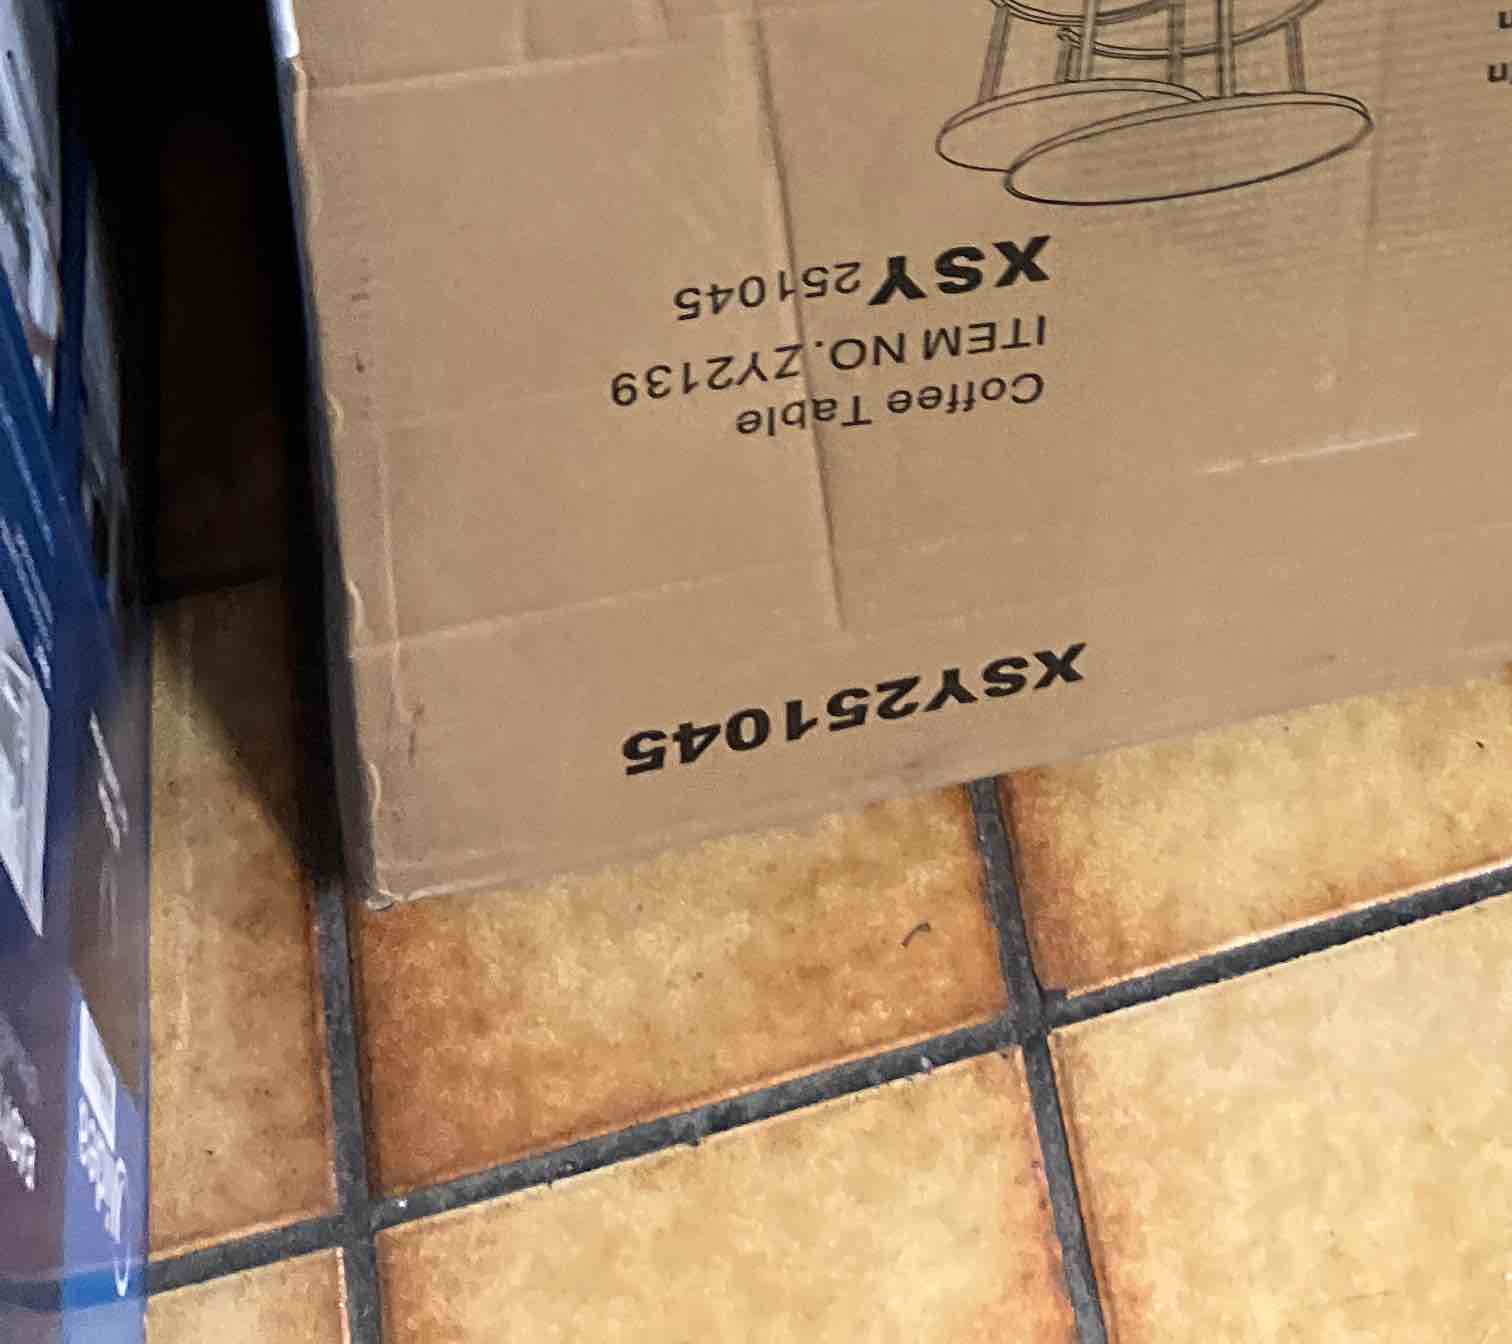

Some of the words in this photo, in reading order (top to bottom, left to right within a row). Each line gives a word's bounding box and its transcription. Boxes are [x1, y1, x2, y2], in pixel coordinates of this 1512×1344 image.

[922, 314, 1049, 363] ITEM
[735, 394, 873, 437] Table
[886, 371, 1045, 415] Coffee
[621, 641, 1088, 777] XSY251045
